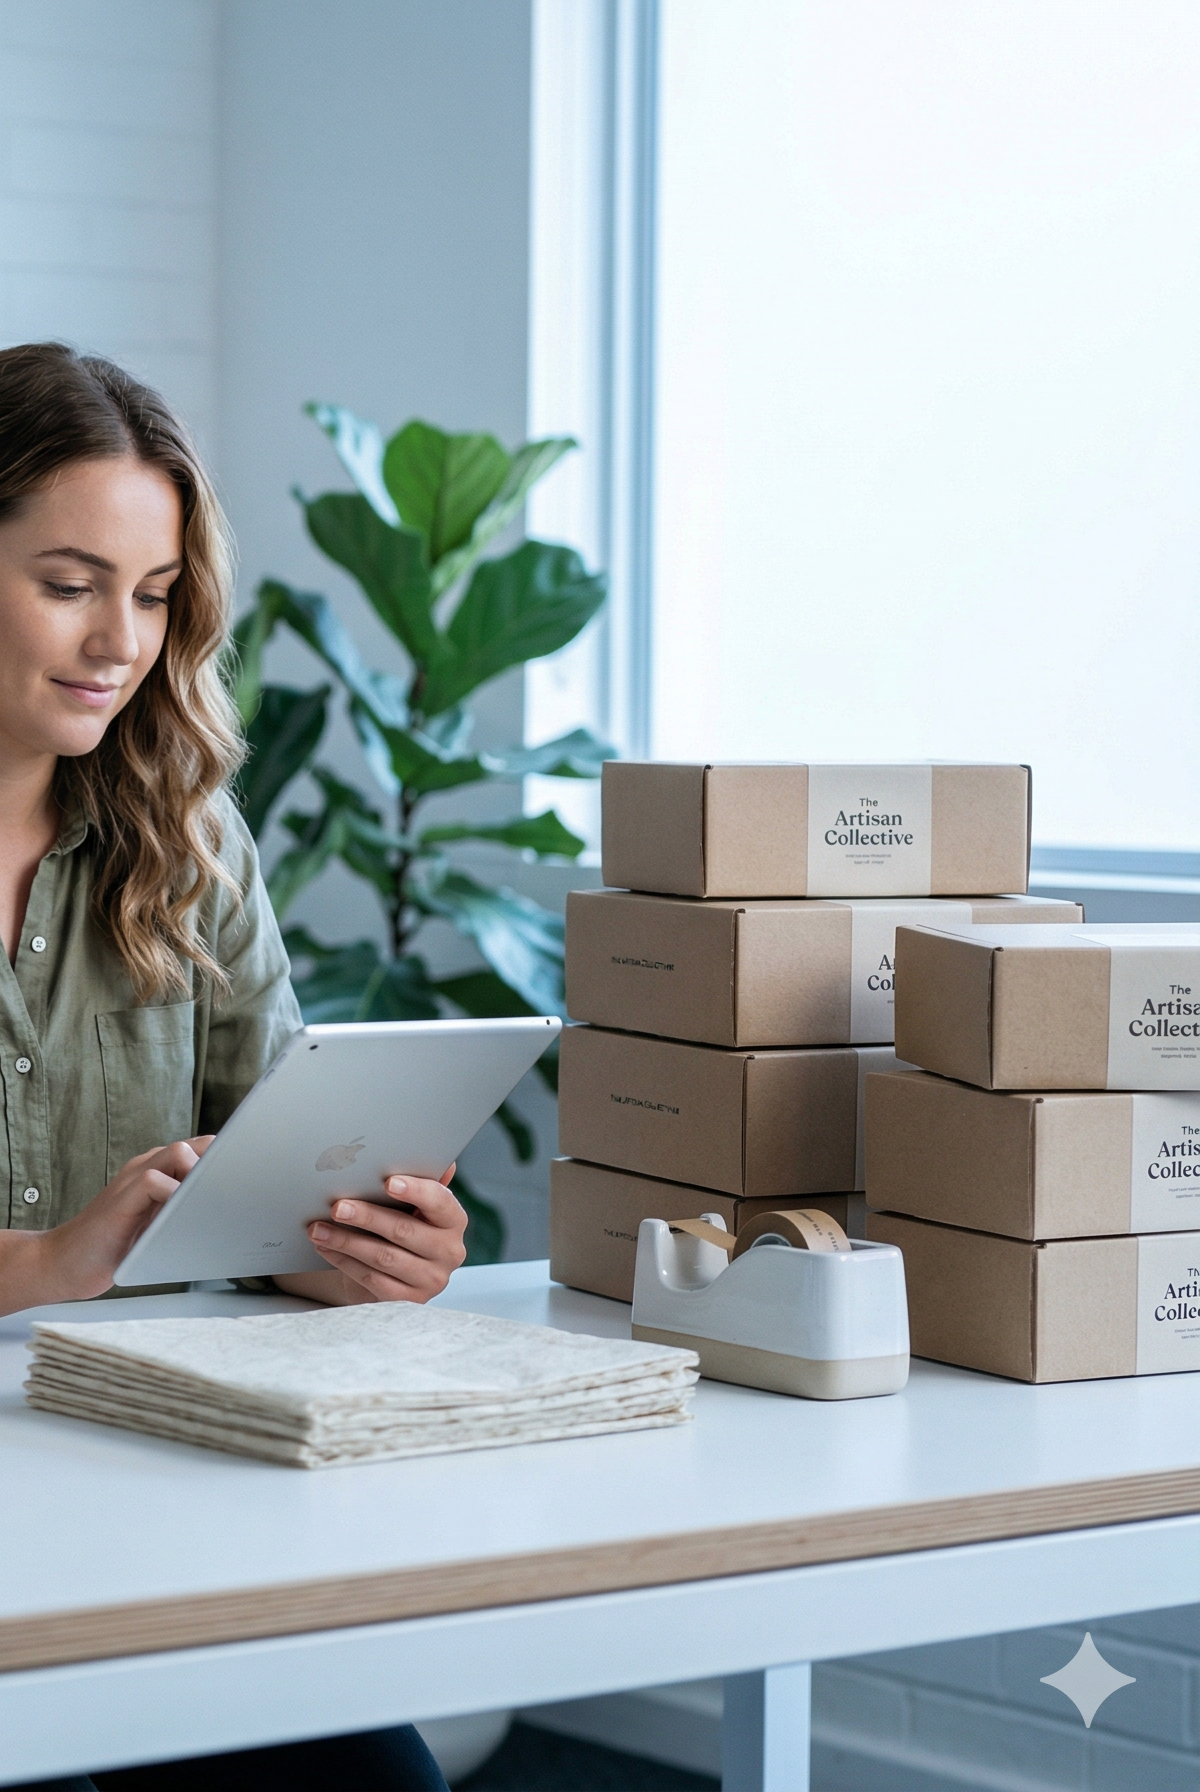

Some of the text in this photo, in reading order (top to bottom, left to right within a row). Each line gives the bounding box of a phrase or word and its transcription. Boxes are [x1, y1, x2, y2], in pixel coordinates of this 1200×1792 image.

[859, 798, 878, 807] The
[835, 809, 903, 826] Artisan
[824, 829, 914, 846] Collective
[1169, 984, 1191, 995] The
[1181, 1126, 1200, 1135] The
[1164, 1280, 1200, 1300] Arti
[1154, 1303, 1200, 1322] Colle
